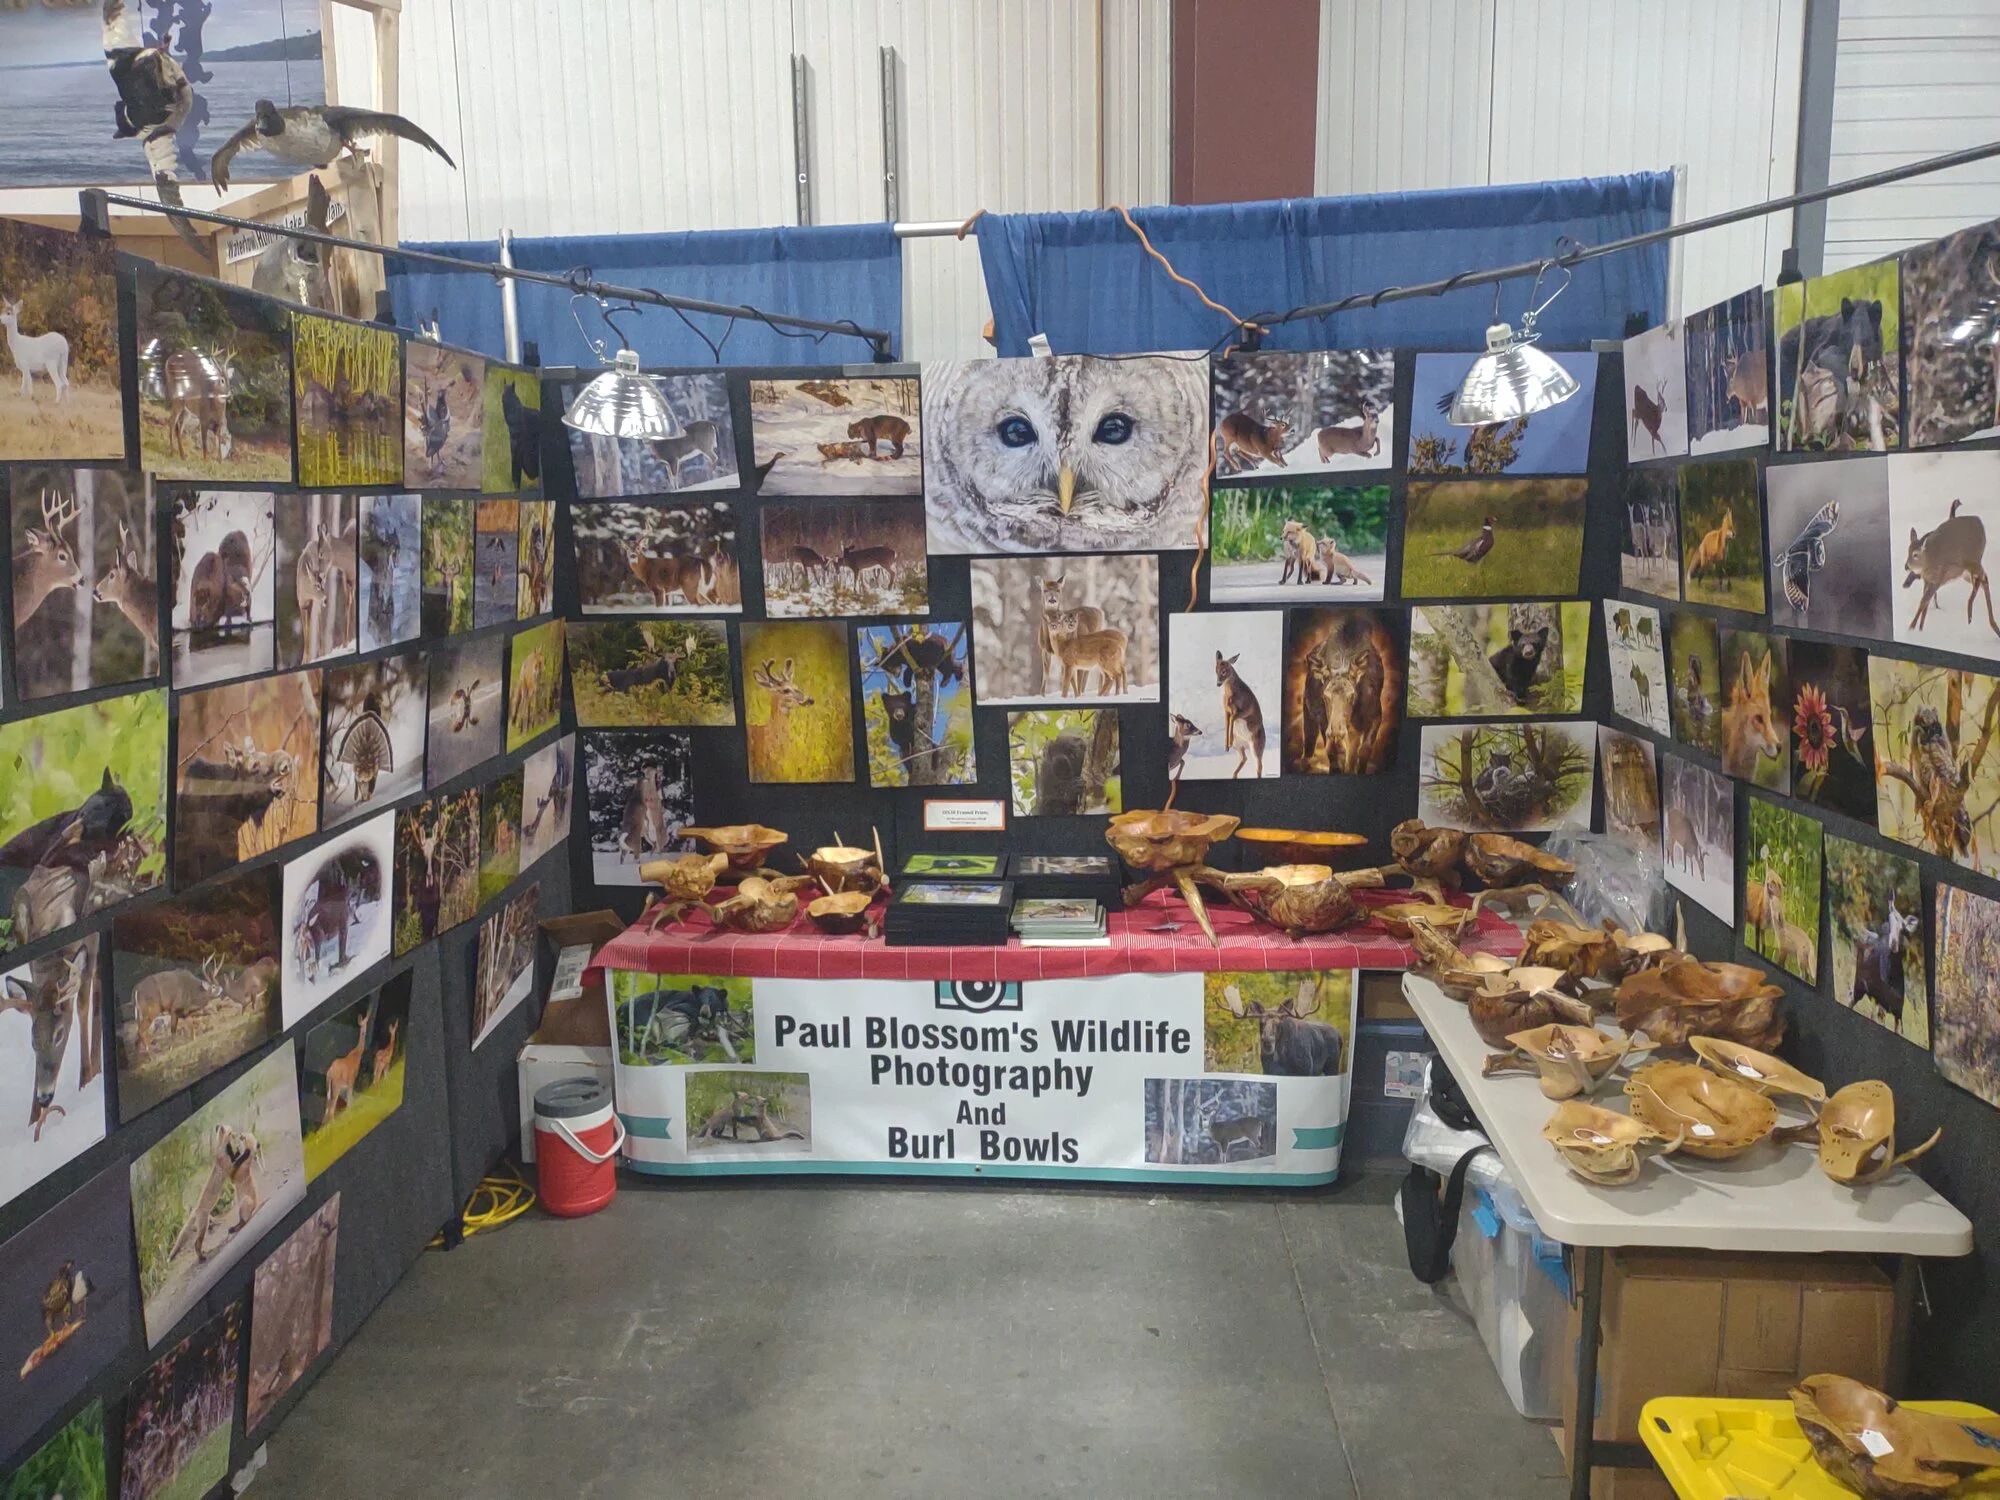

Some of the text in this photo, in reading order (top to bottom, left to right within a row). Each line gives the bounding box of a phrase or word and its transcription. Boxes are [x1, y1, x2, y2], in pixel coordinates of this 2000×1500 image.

[775, 1015, 1190, 1054] Paul Blossom's Wildlife
[871, 1054, 1093, 1098] Photography
[956, 1100, 1006, 1126] And
[888, 1126, 1079, 1163] Burl Bowls
